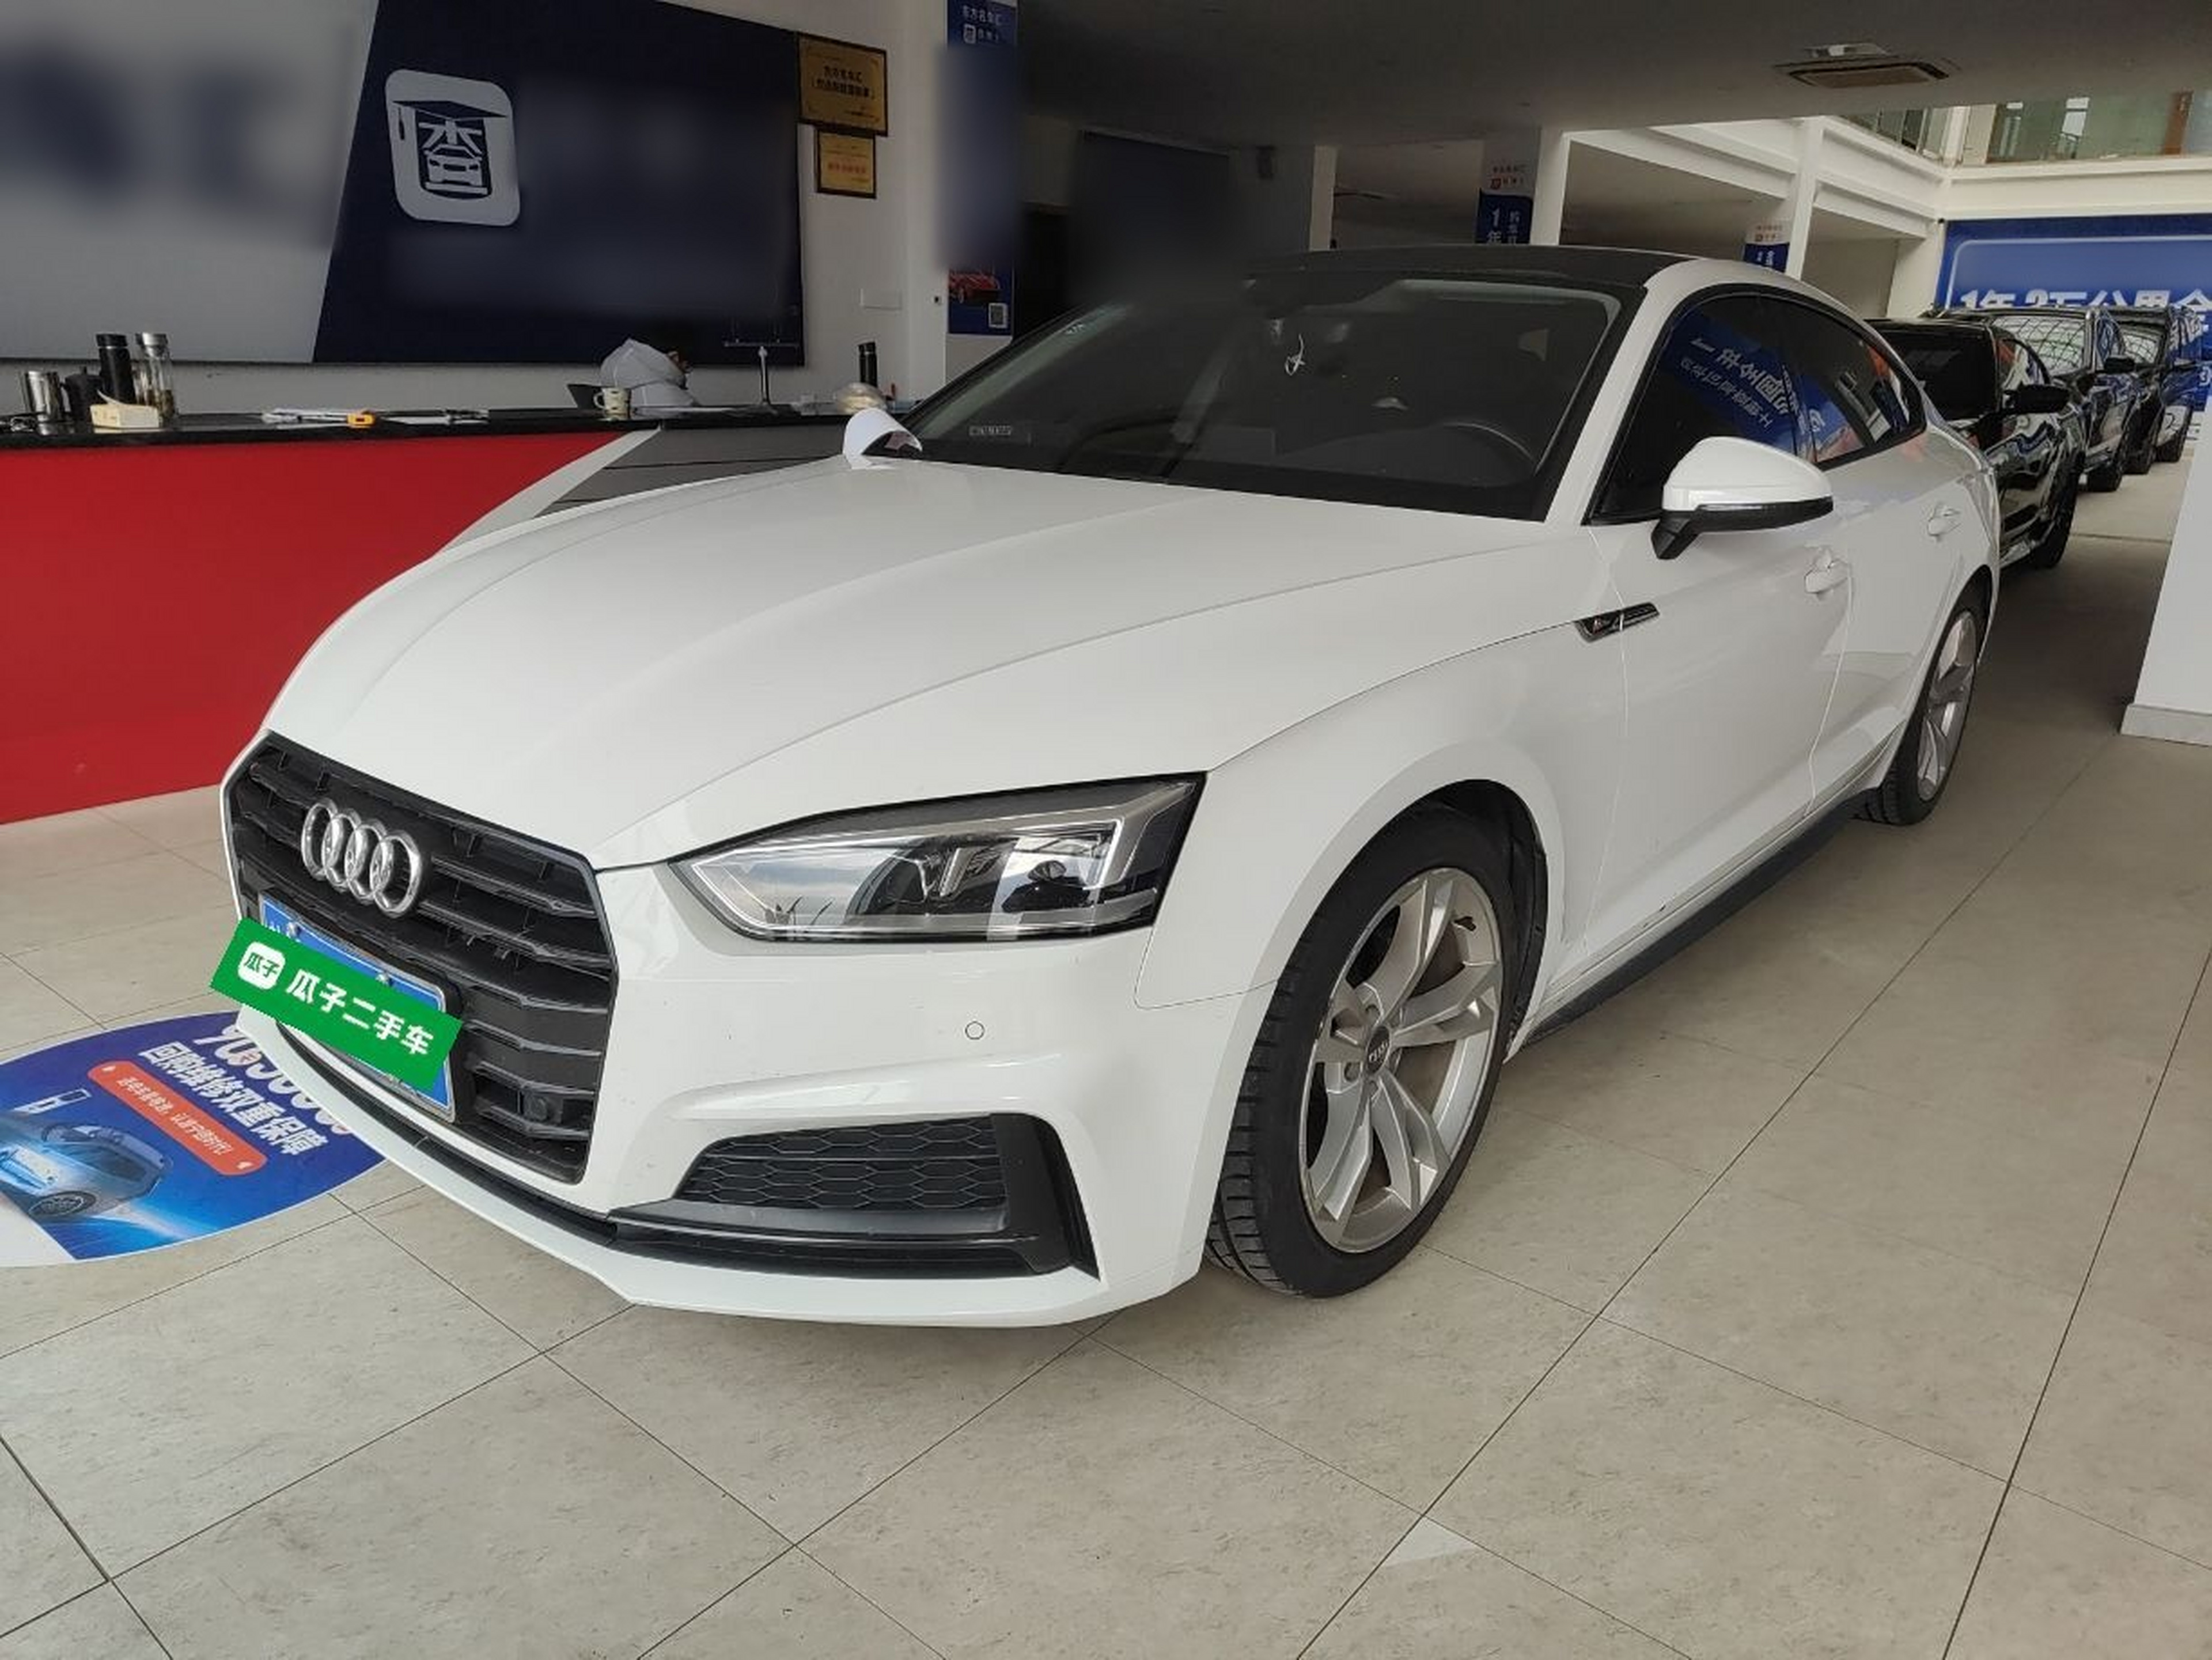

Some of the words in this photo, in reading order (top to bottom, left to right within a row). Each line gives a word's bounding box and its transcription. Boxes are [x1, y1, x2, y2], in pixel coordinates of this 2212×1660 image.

[137, 1041, 329, 1156] 回购维修双重保障
